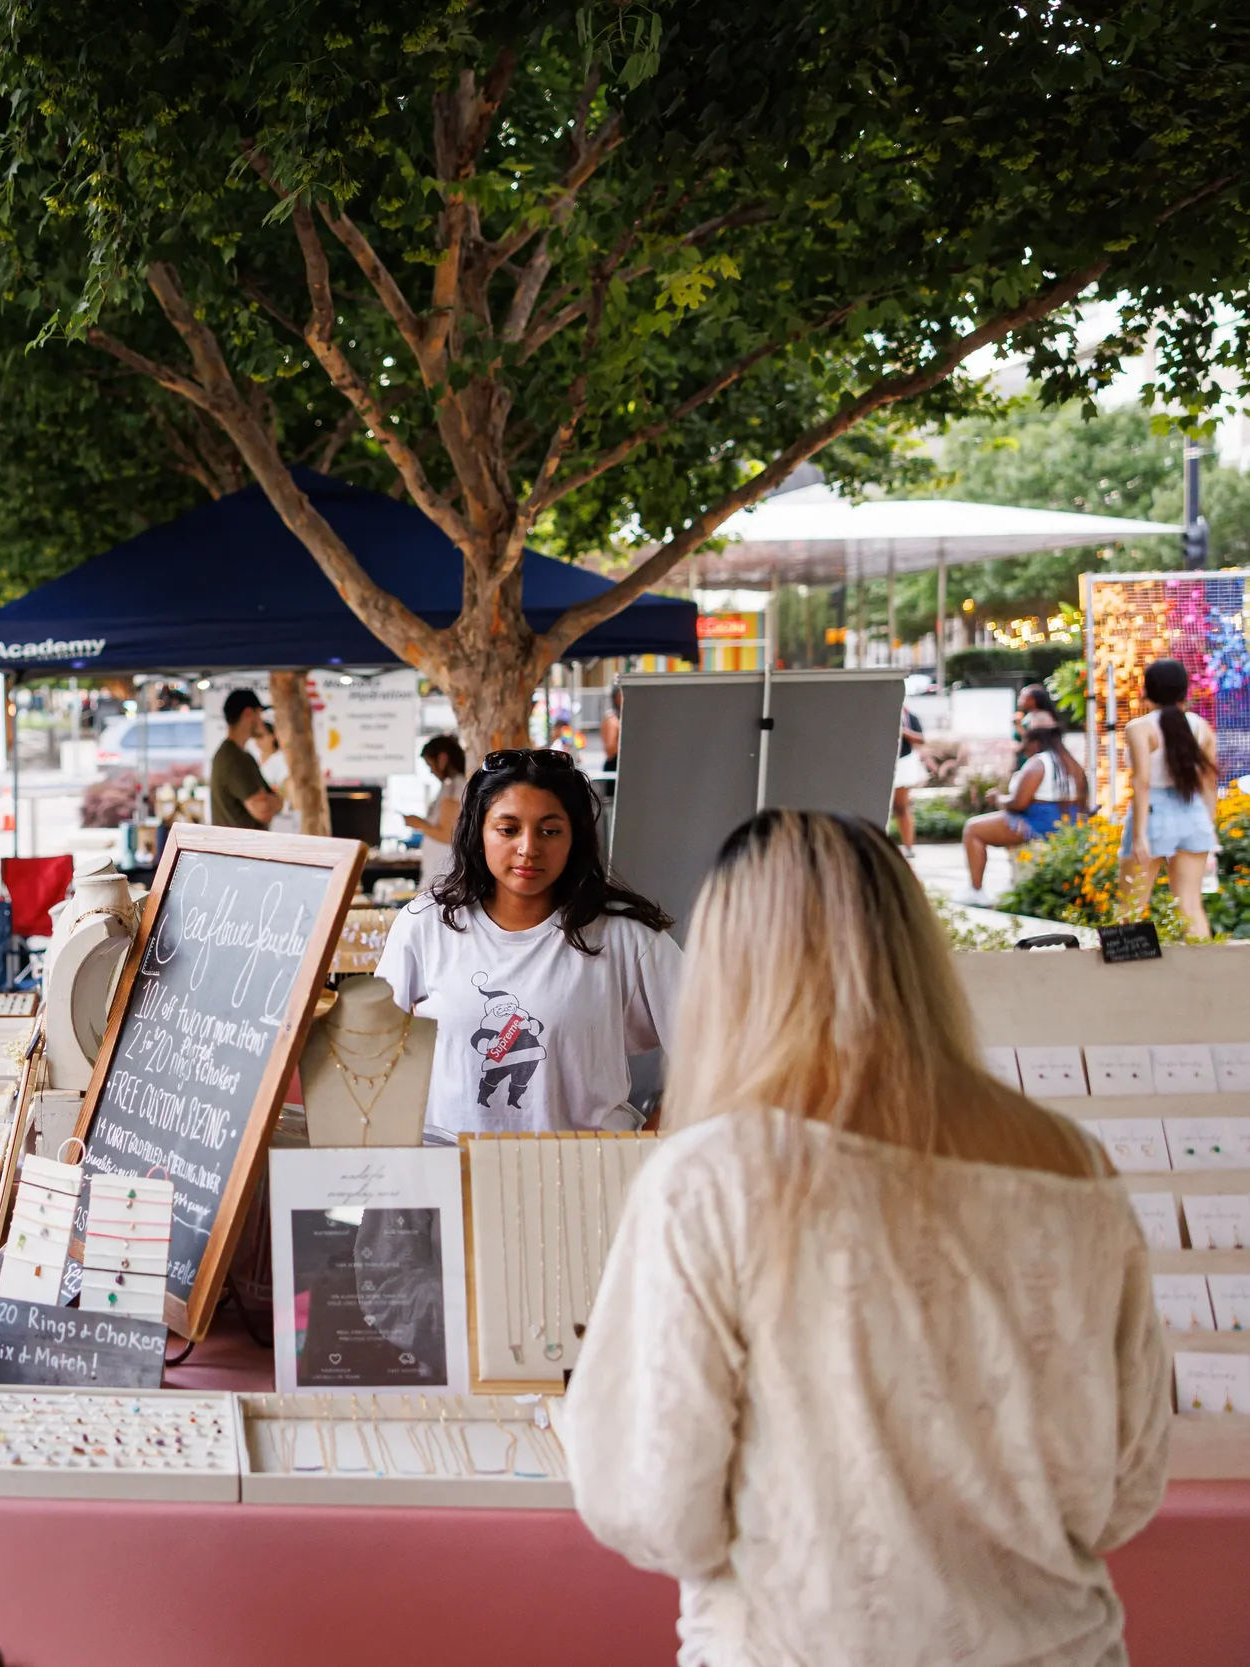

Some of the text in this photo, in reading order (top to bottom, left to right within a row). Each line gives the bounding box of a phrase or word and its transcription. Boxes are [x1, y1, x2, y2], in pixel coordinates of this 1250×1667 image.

[135, 979, 268, 1057] 10% off two or more items
[490, 1019, 520, 1059] Supreme
[125, 1022, 142, 1060] 2
[139, 1030, 153, 1053] for
[168, 1052, 196, 1091] rings
[108, 1070, 230, 1150] FREE CUSTOM SIZING
[95, 1116, 106, 1138] 14
[105, 1123, 132, 1153] KARAT
[128, 1132, 146, 1158] GOLD
[141, 1140, 162, 1166] FILLED
[164, 1150, 198, 1184] STERLING
[194, 1166, 221, 1194] SILVER
[28, 1307, 76, 1343] Rings
[35, 1350, 98, 1376] Match!
